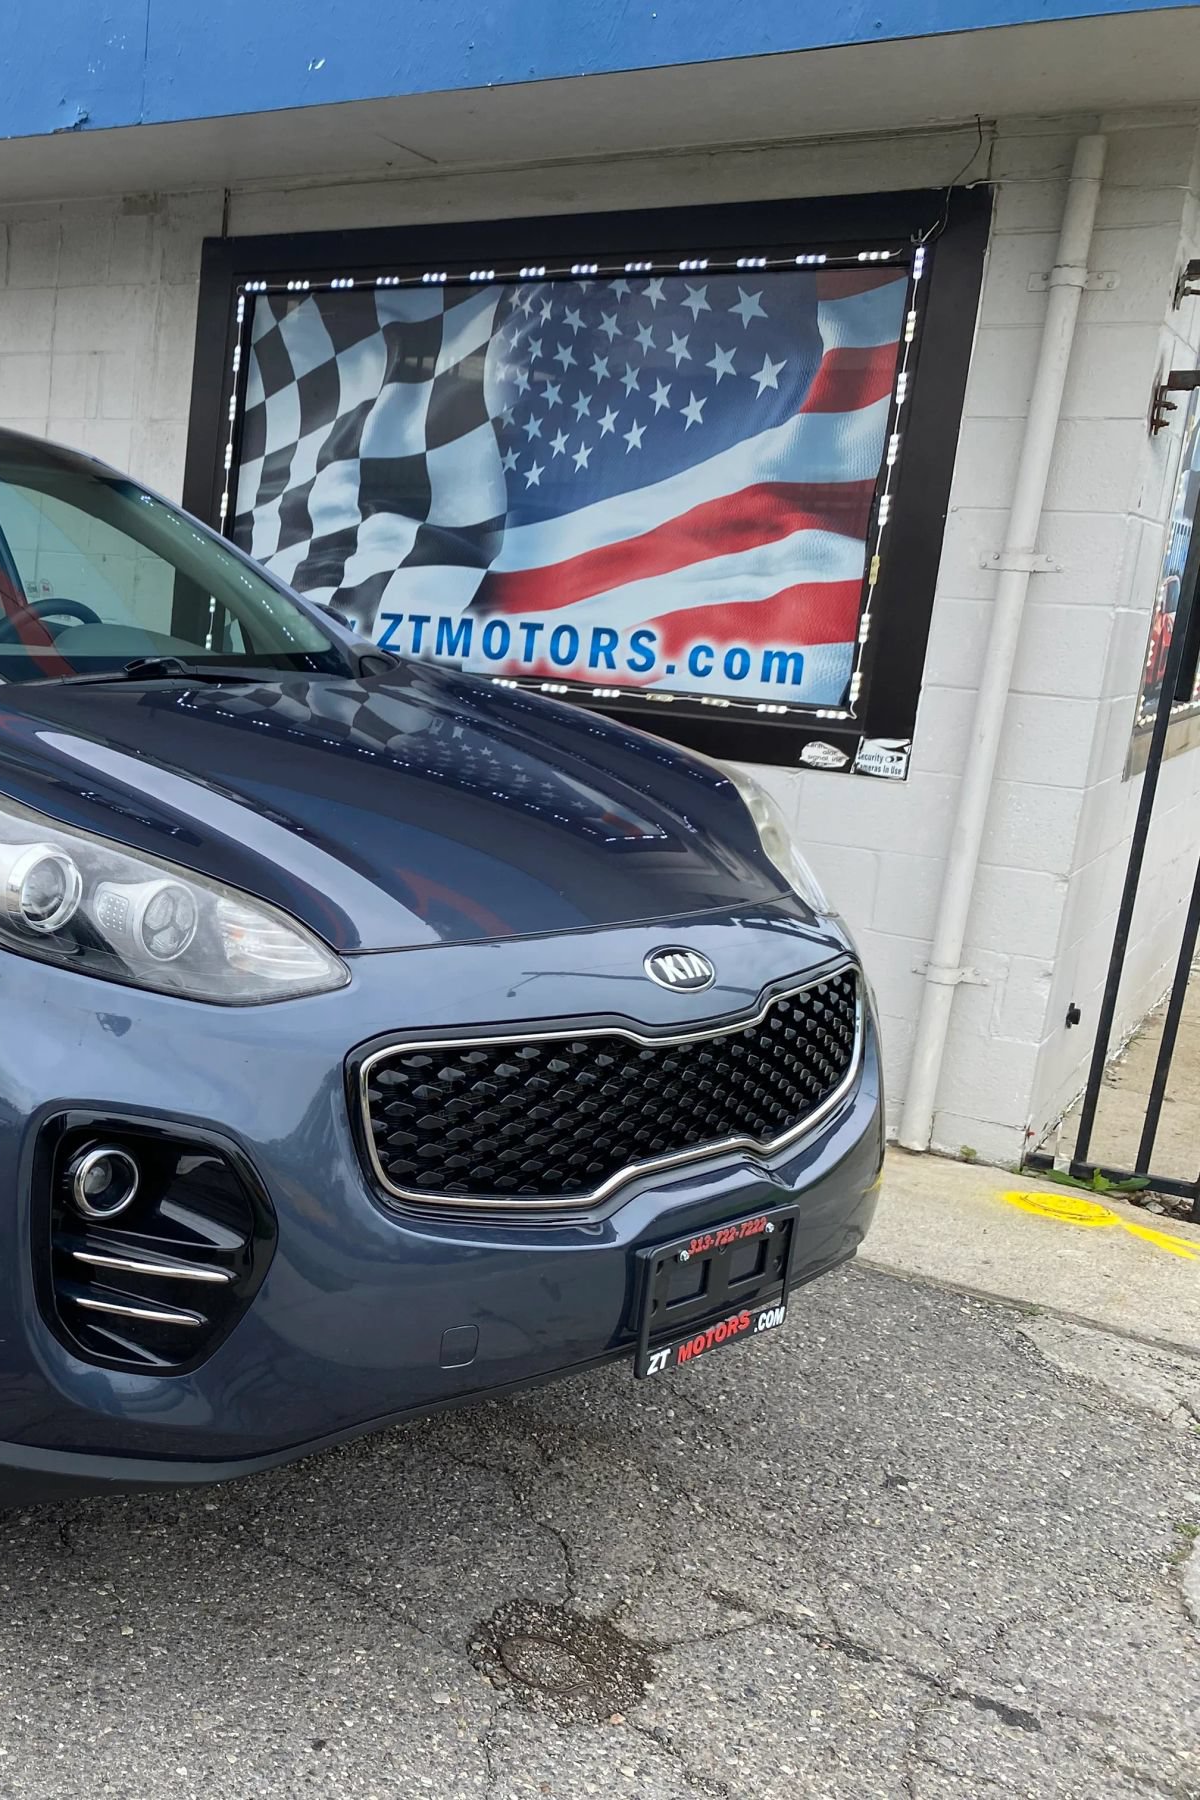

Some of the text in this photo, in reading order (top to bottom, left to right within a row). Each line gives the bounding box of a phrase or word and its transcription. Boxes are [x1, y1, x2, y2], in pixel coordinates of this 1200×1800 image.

[653, 952, 711, 983] KIA
[688, 1216, 768, 1255] 313-722-7222
[646, 1306, 786, 1376] ZT MOTORS .COM
